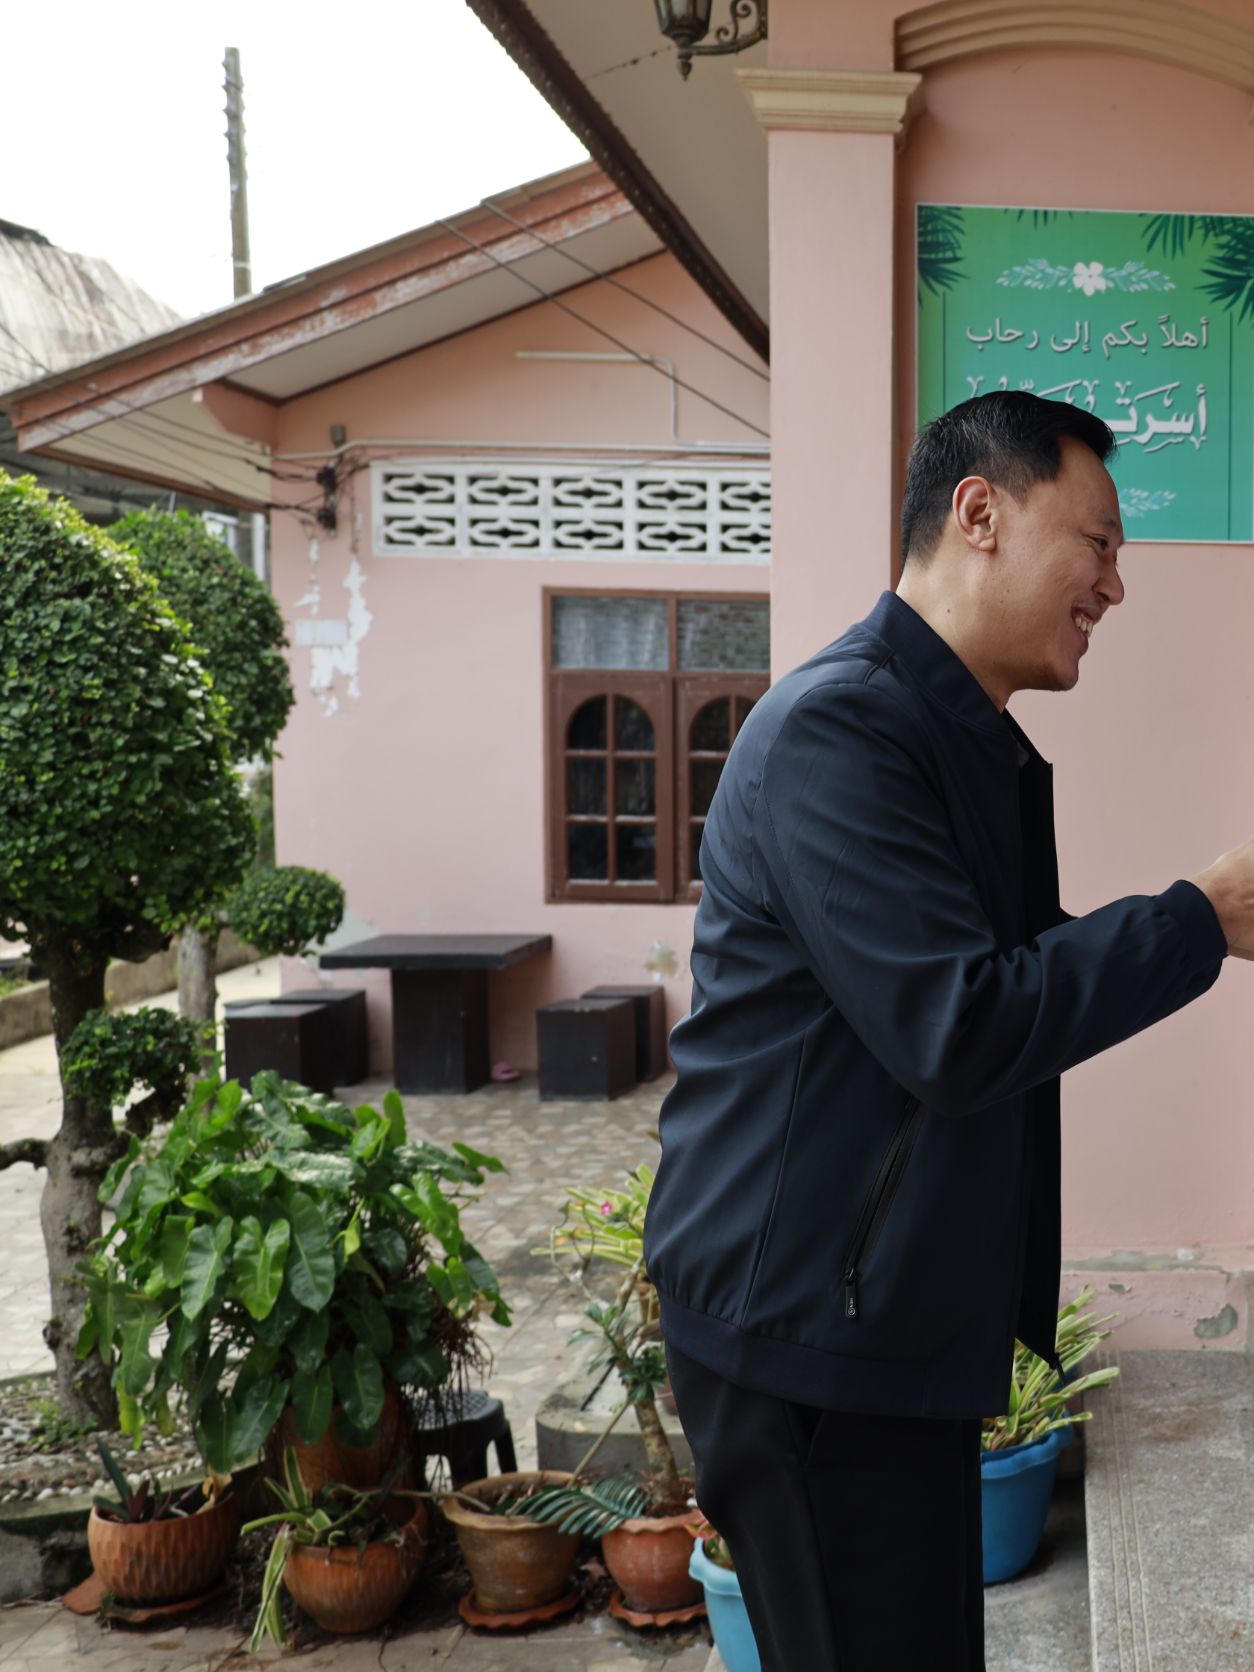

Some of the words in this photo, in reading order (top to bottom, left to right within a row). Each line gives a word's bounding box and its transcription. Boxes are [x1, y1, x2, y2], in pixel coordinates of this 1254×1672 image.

[966, 317, 1040, 350] رحاب
[1051, 320, 1091, 353] إلى
[1101, 320, 1149, 359] بكم
[1159, 315, 1209, 349] أهلاً
